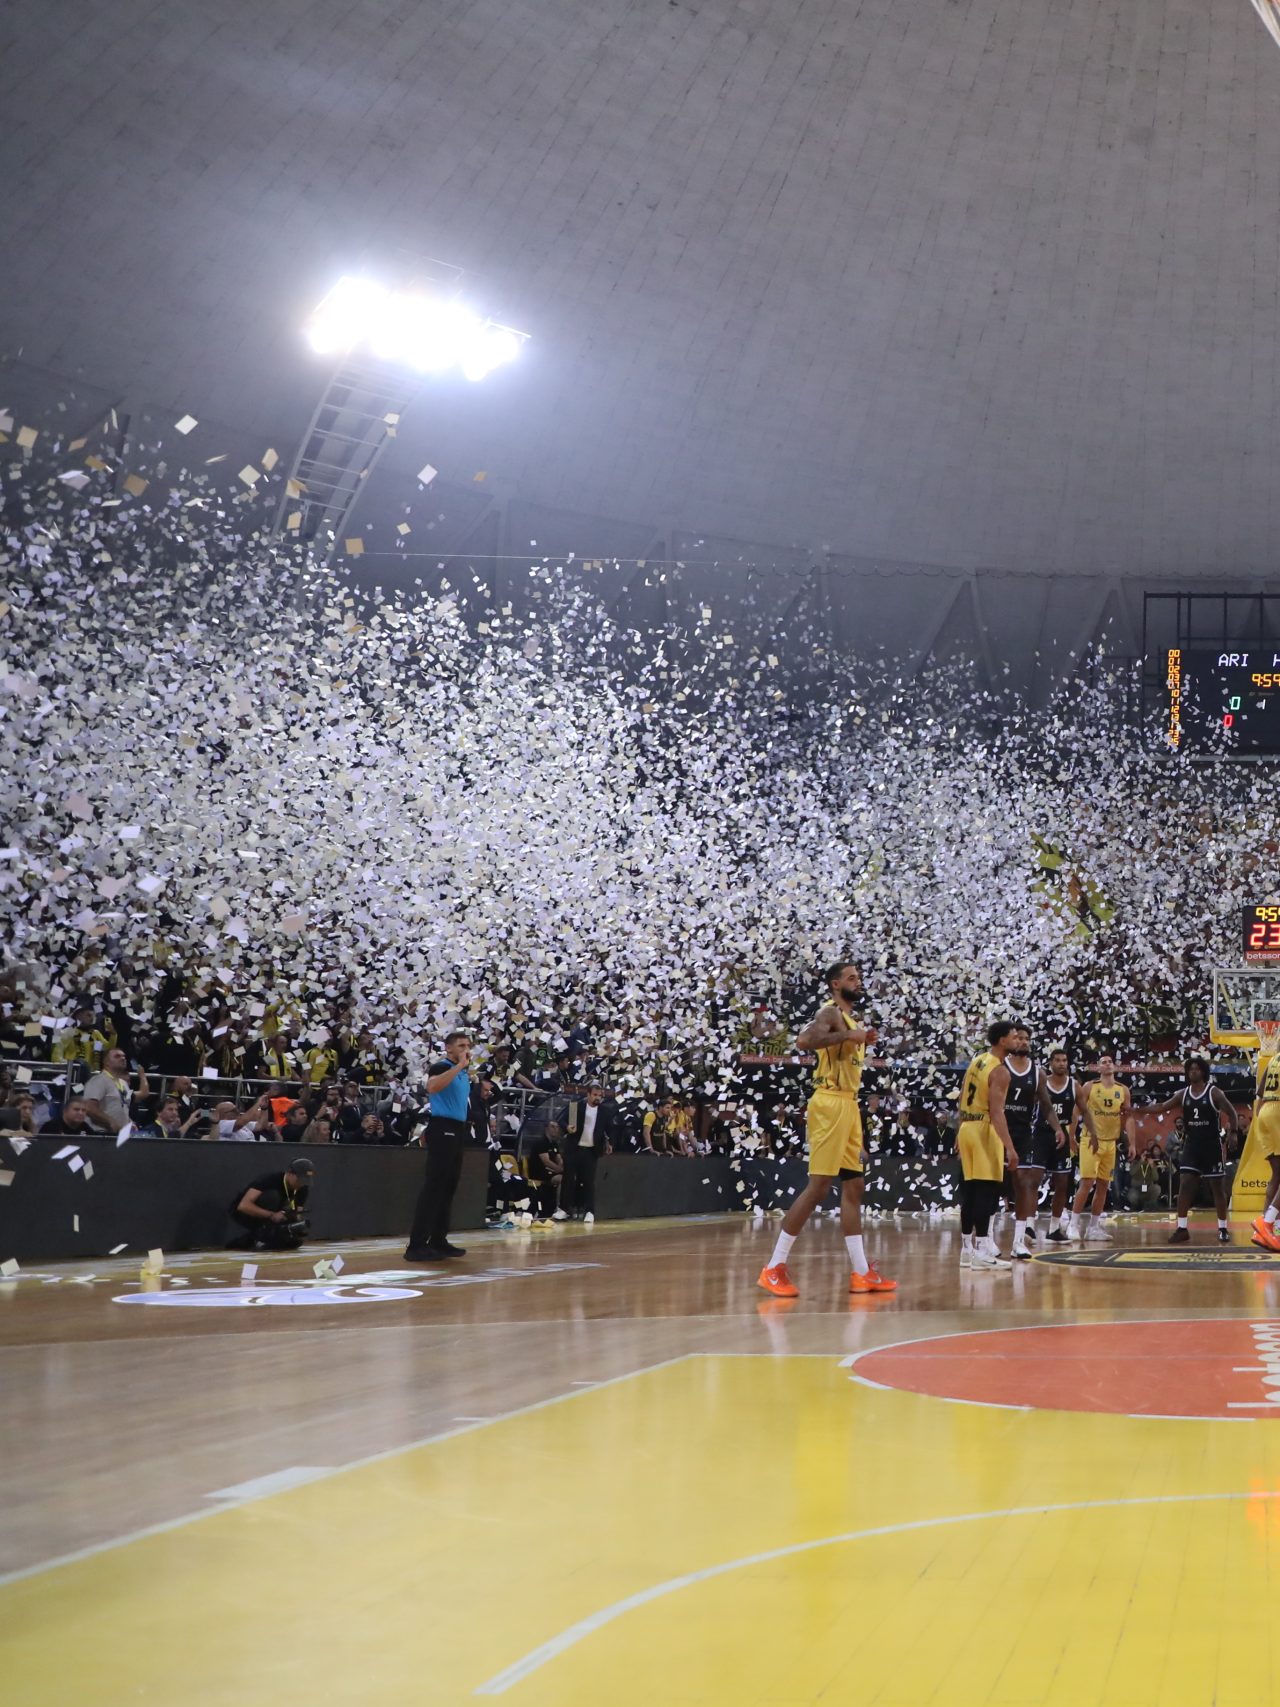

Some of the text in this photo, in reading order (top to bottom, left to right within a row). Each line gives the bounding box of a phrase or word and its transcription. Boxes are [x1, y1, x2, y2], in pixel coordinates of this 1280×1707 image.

[1168, 649, 1180, 657] 00
[1218, 653, 1249, 667] ARI
[1230, 696, 1241, 710] 0
[1223, 715, 1233, 727] 0
[1014, 1088, 1021, 1100] 7
[1104, 1099, 1113, 1107] 13
[1193, 1108, 1199, 1119] 2
[1241, 1179, 1268, 1188] bets
